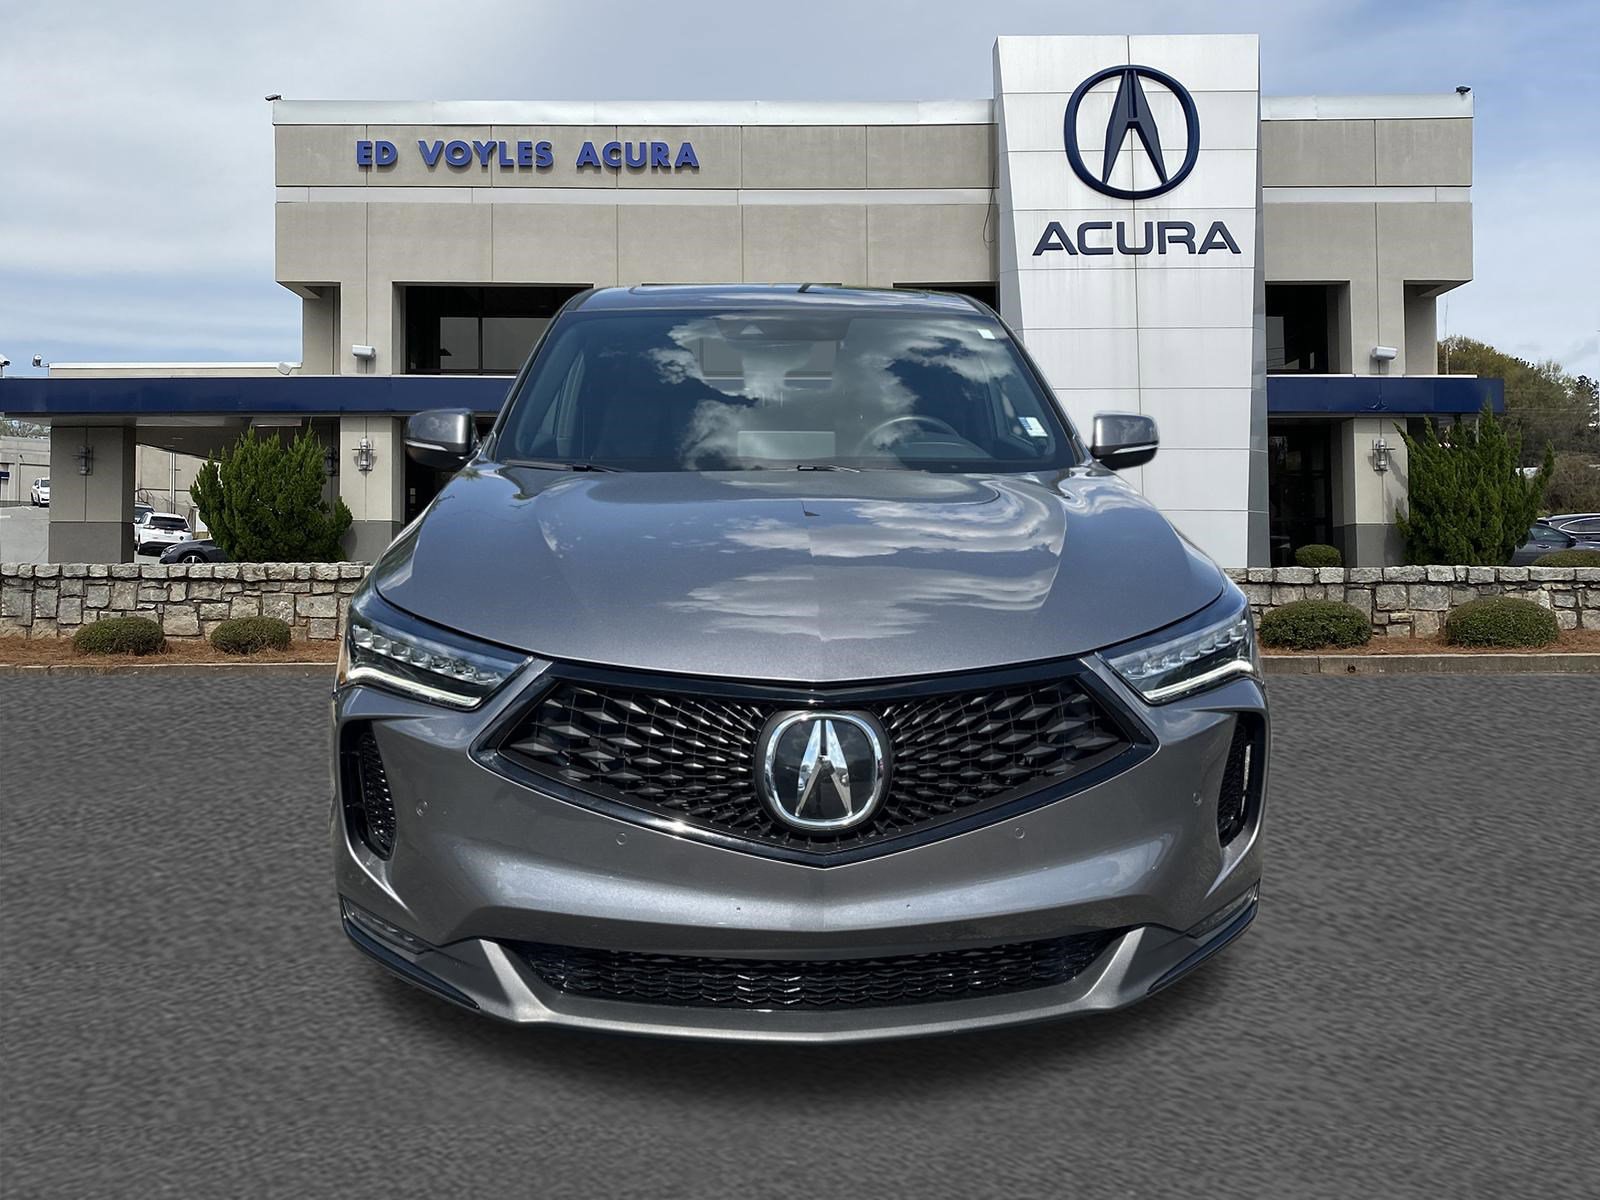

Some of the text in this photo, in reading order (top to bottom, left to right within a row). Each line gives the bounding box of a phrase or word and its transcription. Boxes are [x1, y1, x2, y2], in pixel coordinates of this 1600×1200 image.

[356, 139, 700, 169] ED VOYLES ACURA
[1032, 220, 1242, 256] ACURA
